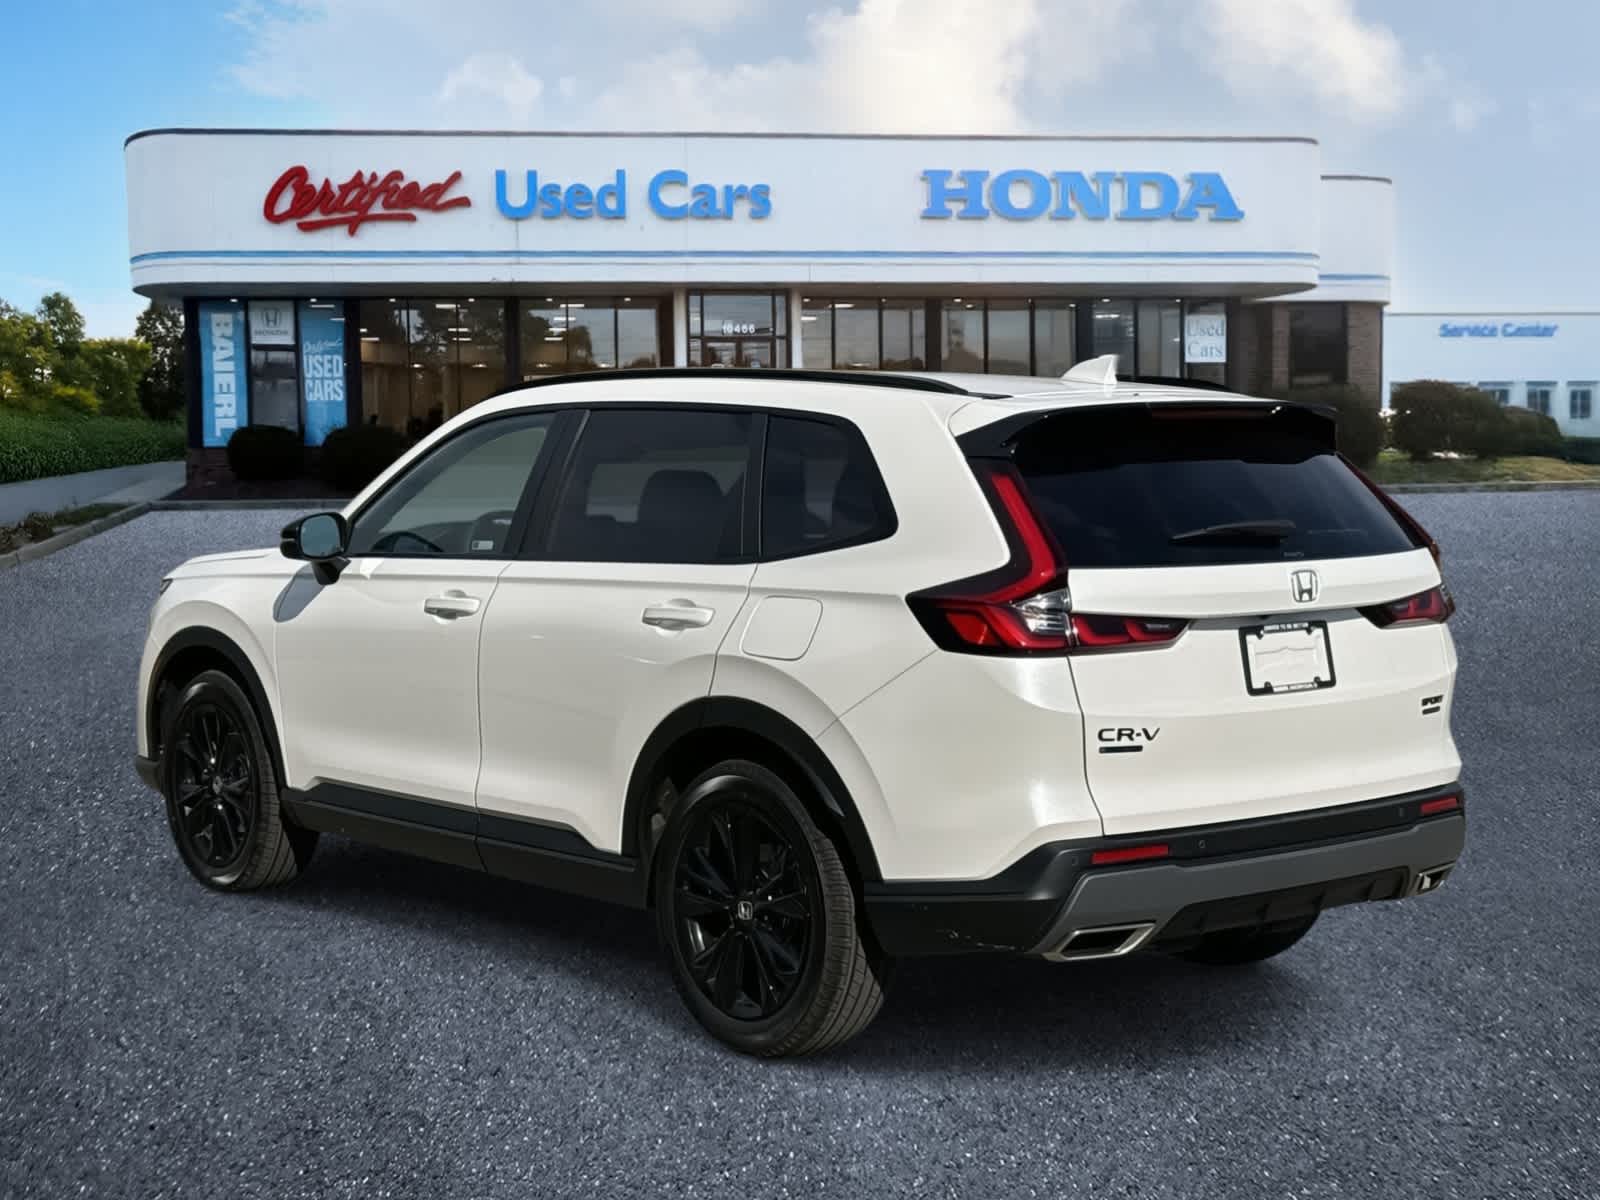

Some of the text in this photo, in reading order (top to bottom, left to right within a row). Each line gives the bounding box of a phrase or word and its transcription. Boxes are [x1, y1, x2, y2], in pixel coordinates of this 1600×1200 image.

[264, 165, 471, 237] Certified
[495, 169, 772, 220] Used Cars
[920, 168, 1245, 222] HONDA
[1187, 319, 1225, 336] Used
[1187, 341, 1223, 358] Cars
[211, 313, 236, 437] BAIERL
[303, 355, 343, 378] USED
[305, 379, 345, 401] CARS
[1097, 727, 1161, 742] CR-V
